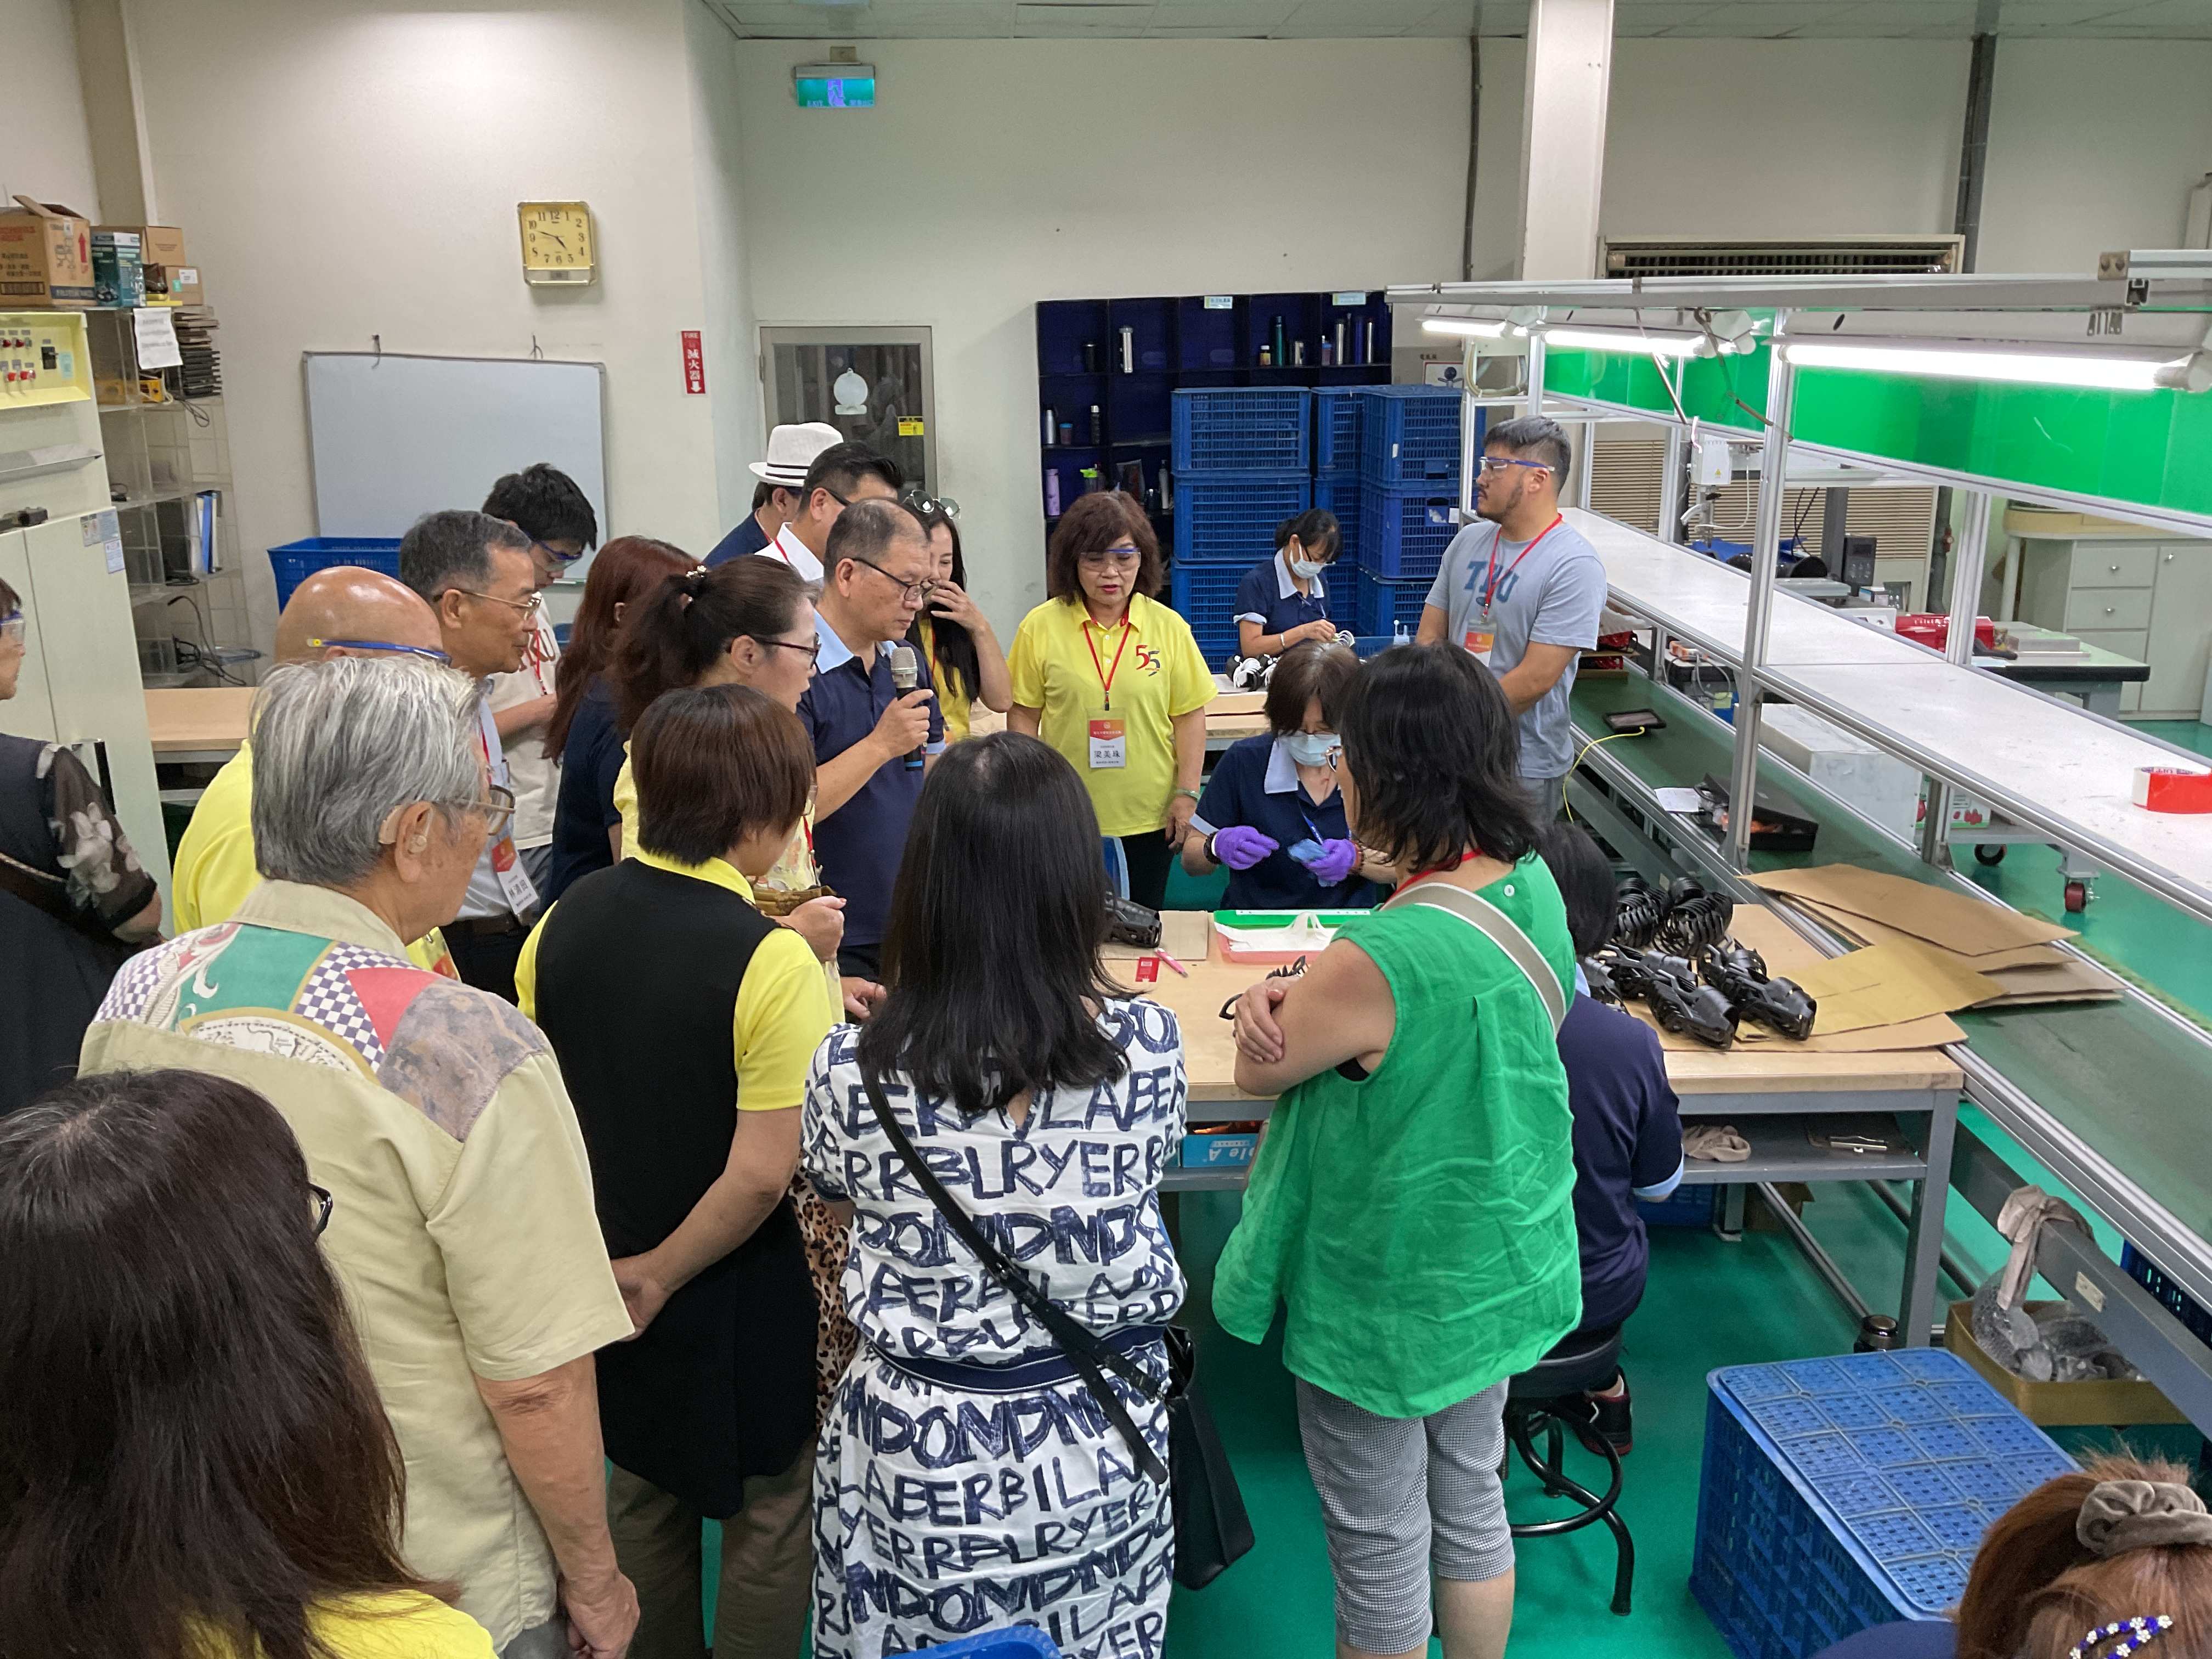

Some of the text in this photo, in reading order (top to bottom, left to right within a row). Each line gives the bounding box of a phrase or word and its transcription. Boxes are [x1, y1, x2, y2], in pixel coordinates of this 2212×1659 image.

[538, 212, 546, 221] 11
[550, 211, 560, 220] 12
[566, 212, 569, 221] 1
[529, 220, 537, 230] 10
[576, 218, 582, 228] 2
[687, 348, 701, 380] 滅火器
